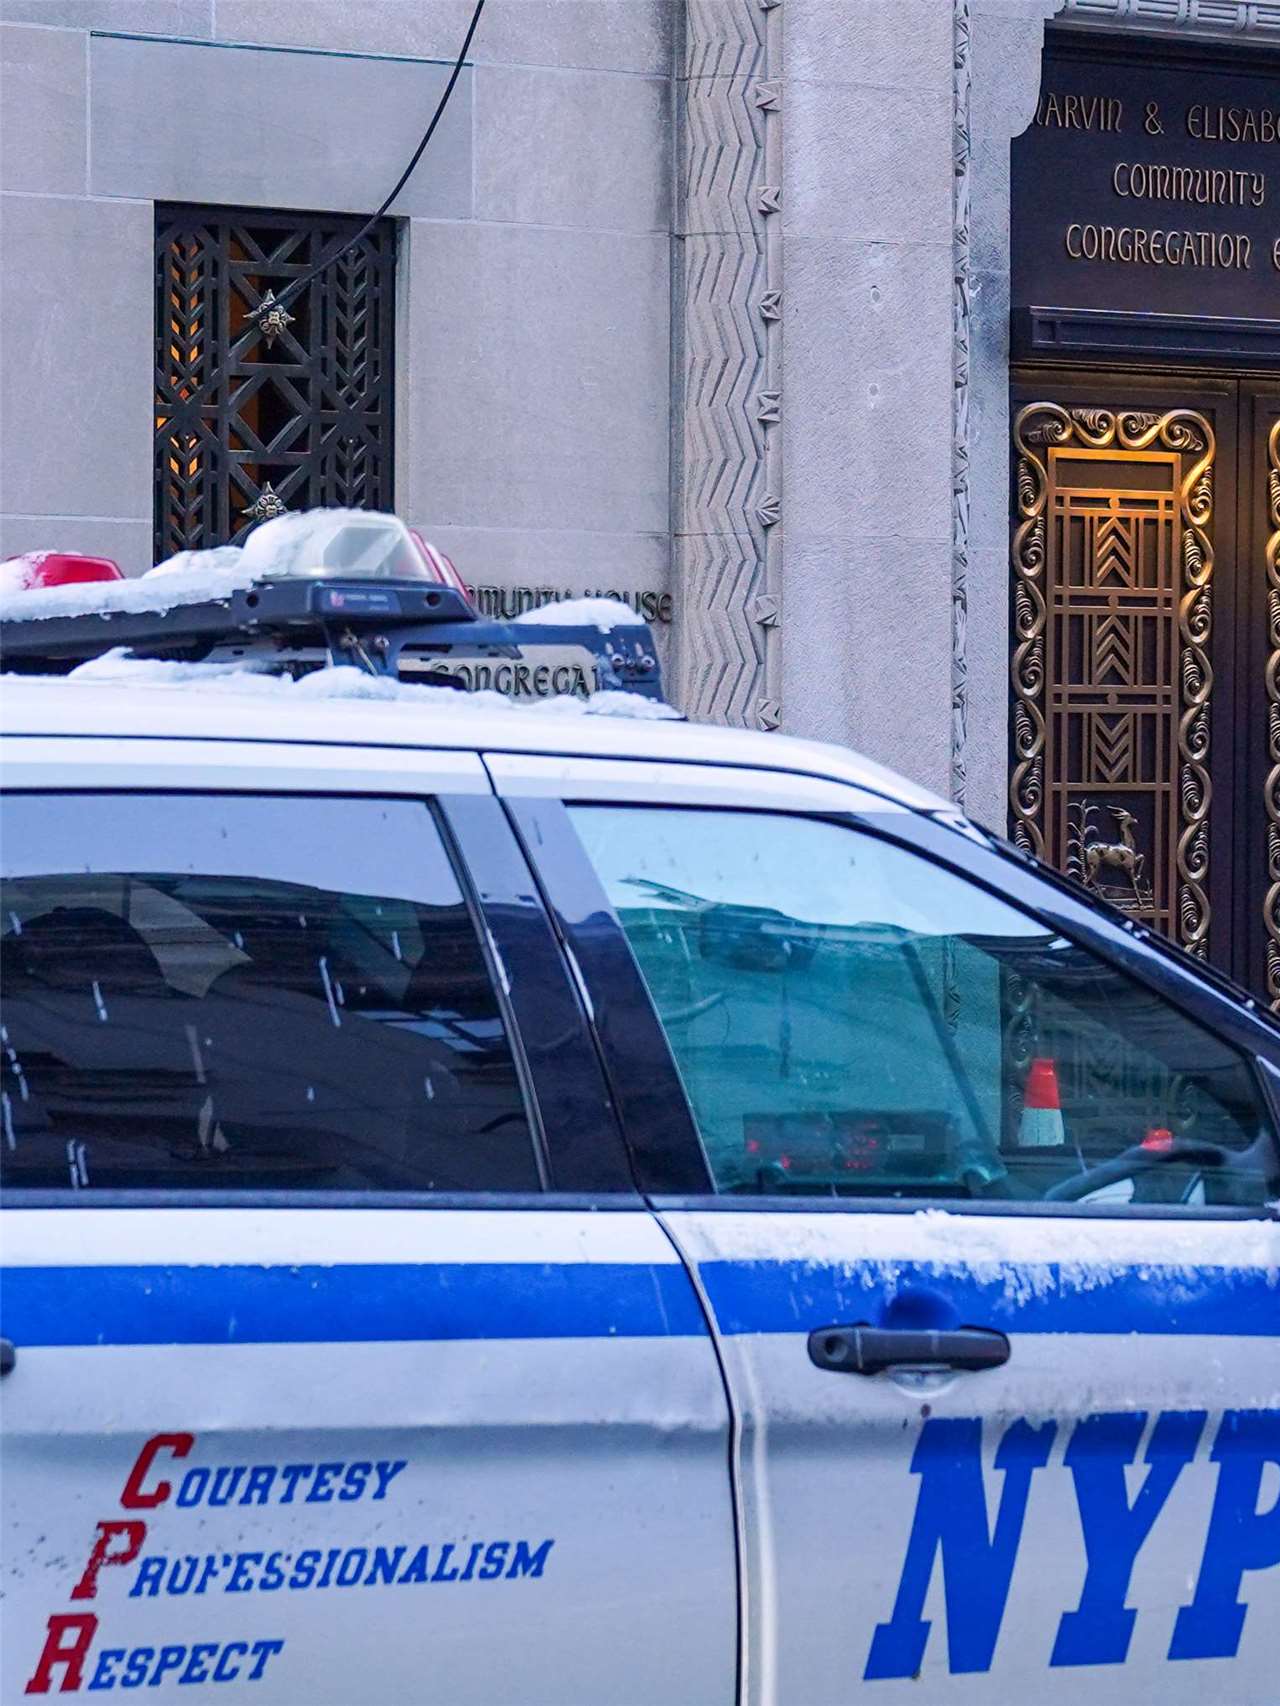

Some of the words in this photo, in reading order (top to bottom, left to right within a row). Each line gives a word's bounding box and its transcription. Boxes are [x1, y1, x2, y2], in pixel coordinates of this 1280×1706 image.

[1143, 100, 1165, 135] &
[1113, 161, 1266, 207] COMMUNITY
[1065, 222, 1252, 270] CONGREGATION
[583, 589, 674, 623] USE
[431, 663, 599, 699] ONGREGA
[121, 1432, 407, 1509] COURTESY
[70, 1520, 555, 1601] PROFESSIONALISM
[25, 1613, 284, 1695] RESPECT
